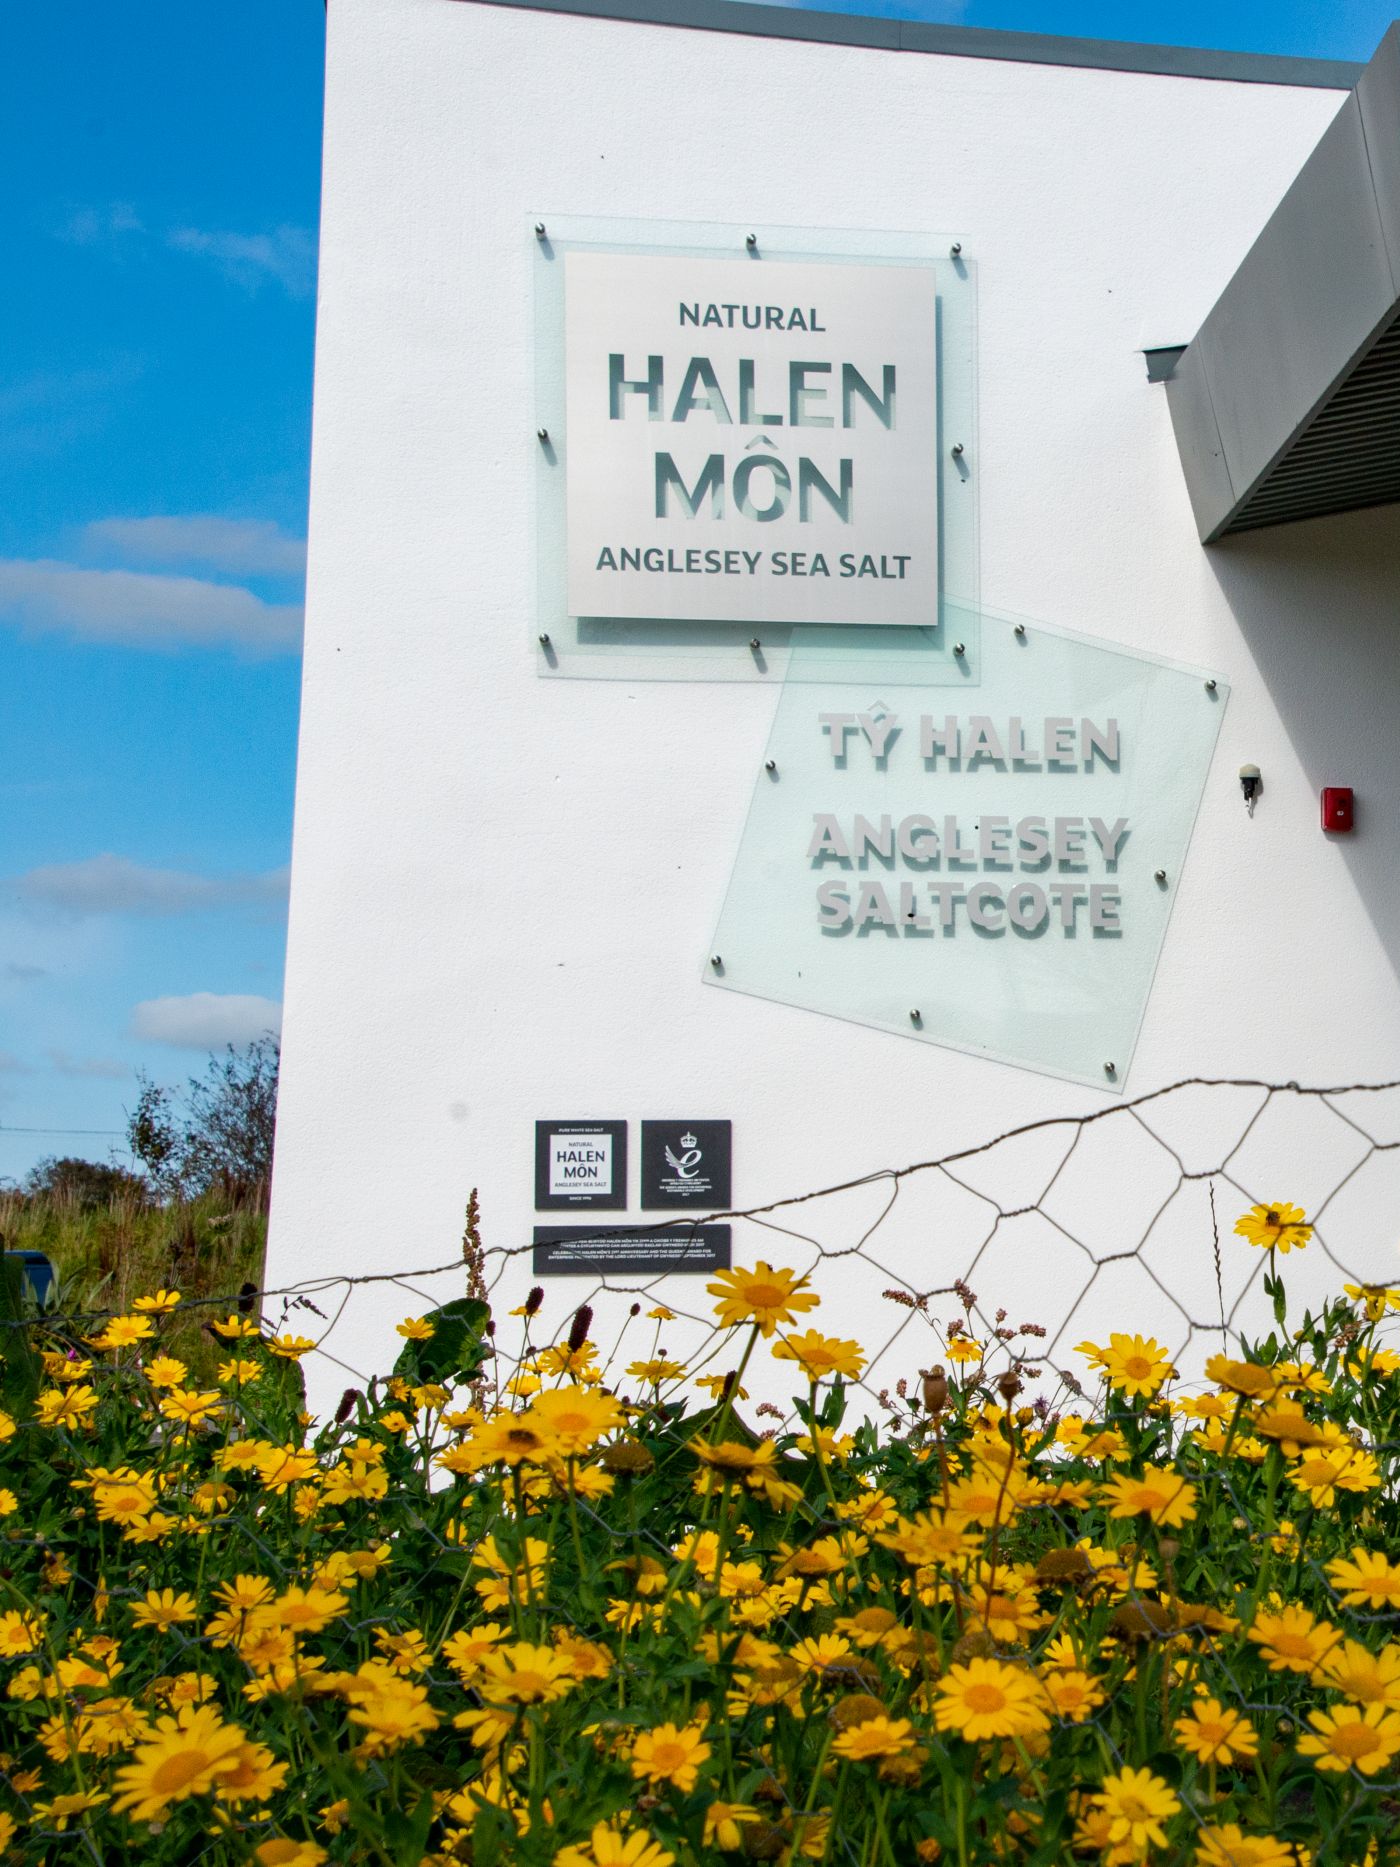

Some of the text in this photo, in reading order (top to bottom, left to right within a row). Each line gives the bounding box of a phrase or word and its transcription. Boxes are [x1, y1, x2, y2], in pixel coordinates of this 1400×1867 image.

[679, 302, 826, 332] NATURAL
[609, 353, 897, 430] HALEN
[655, 435, 854, 524] MÔN
[596, 546, 911, 579] ANGLESEY SEA SALT
[919, 714, 1118, 761] HALEN
[806, 814, 1129, 861] ANGLESEY
[815, 880, 1121, 929] SALTCOTE
[557, 1151, 605, 1162] HALEN
[564, 1163, 597, 1178] MÔN
